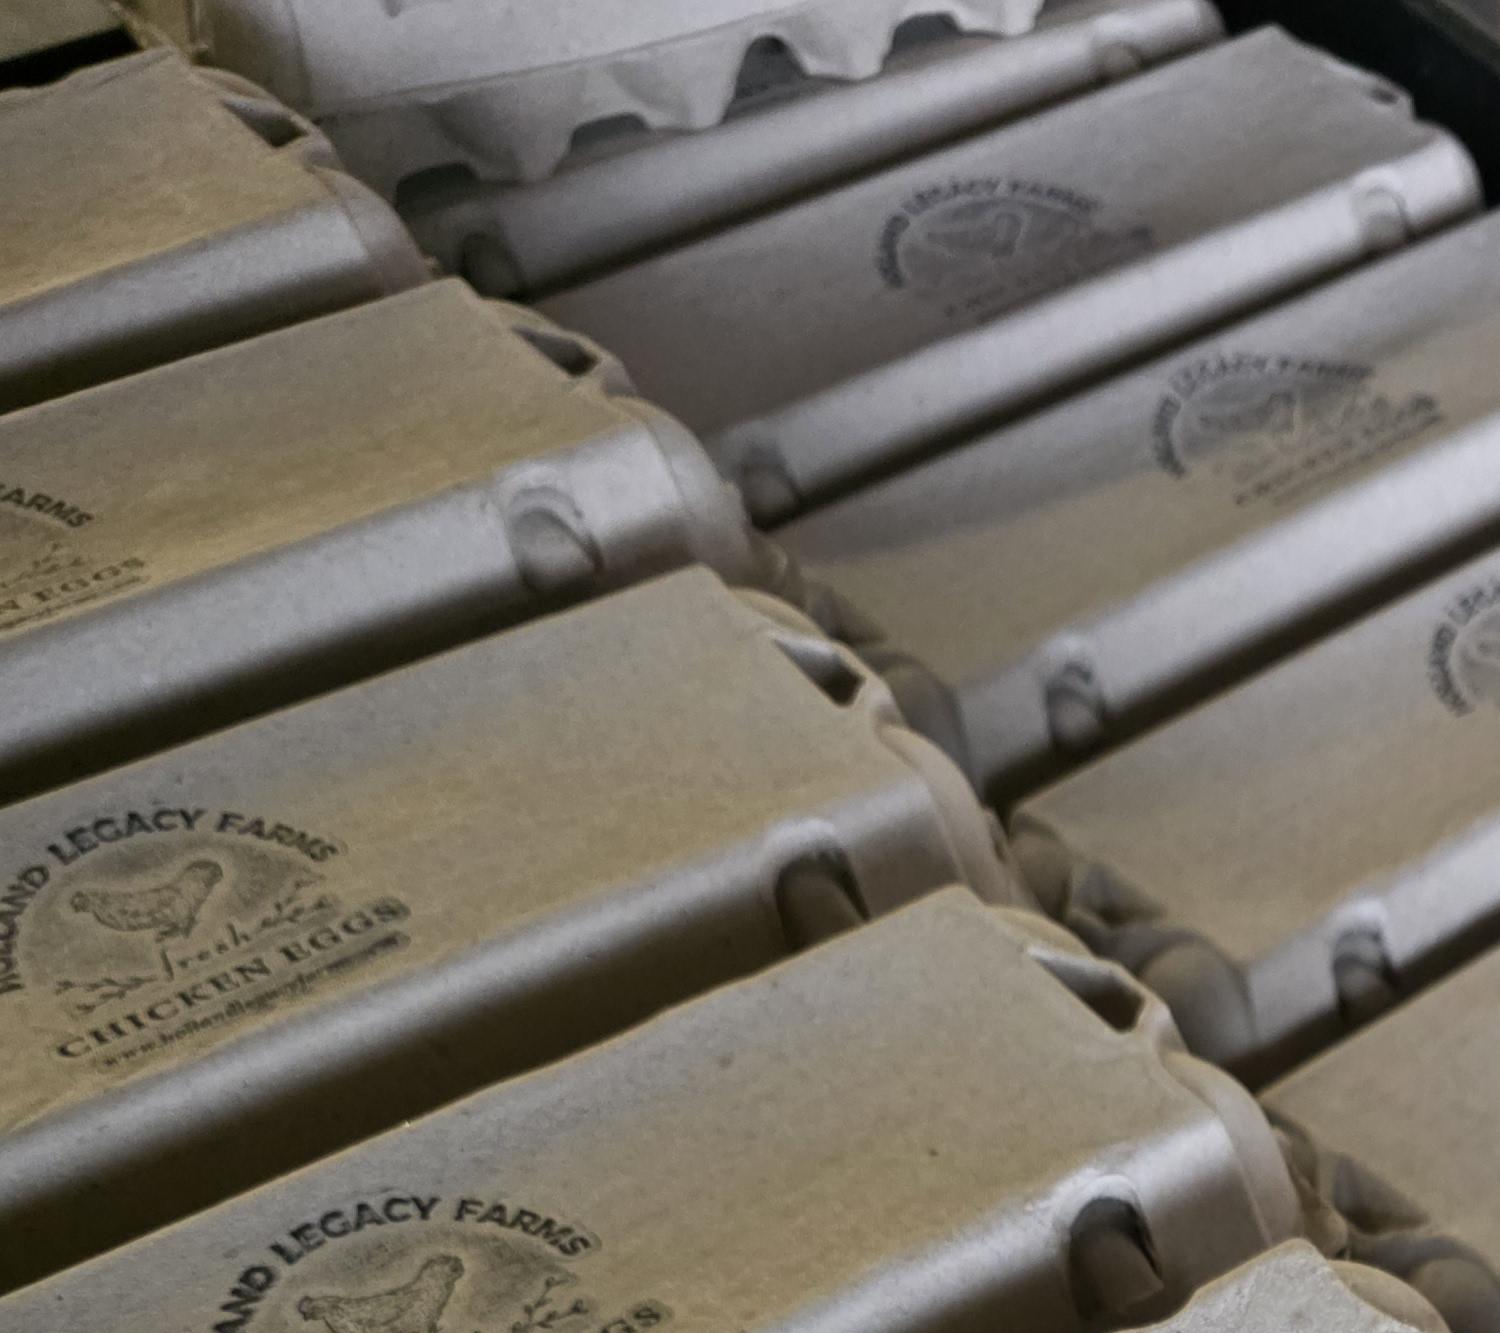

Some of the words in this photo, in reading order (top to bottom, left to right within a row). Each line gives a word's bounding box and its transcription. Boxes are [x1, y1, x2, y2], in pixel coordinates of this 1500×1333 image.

[0, 485, 94, 528] ARMS
[48, 808, 206, 867] LEGACY
[216, 811, 338, 862] FARMS
[57, 957, 272, 1059] CHICKEN
[270, 1197, 440, 1264] LEGACY
[453, 1199, 591, 1257] FARMS
